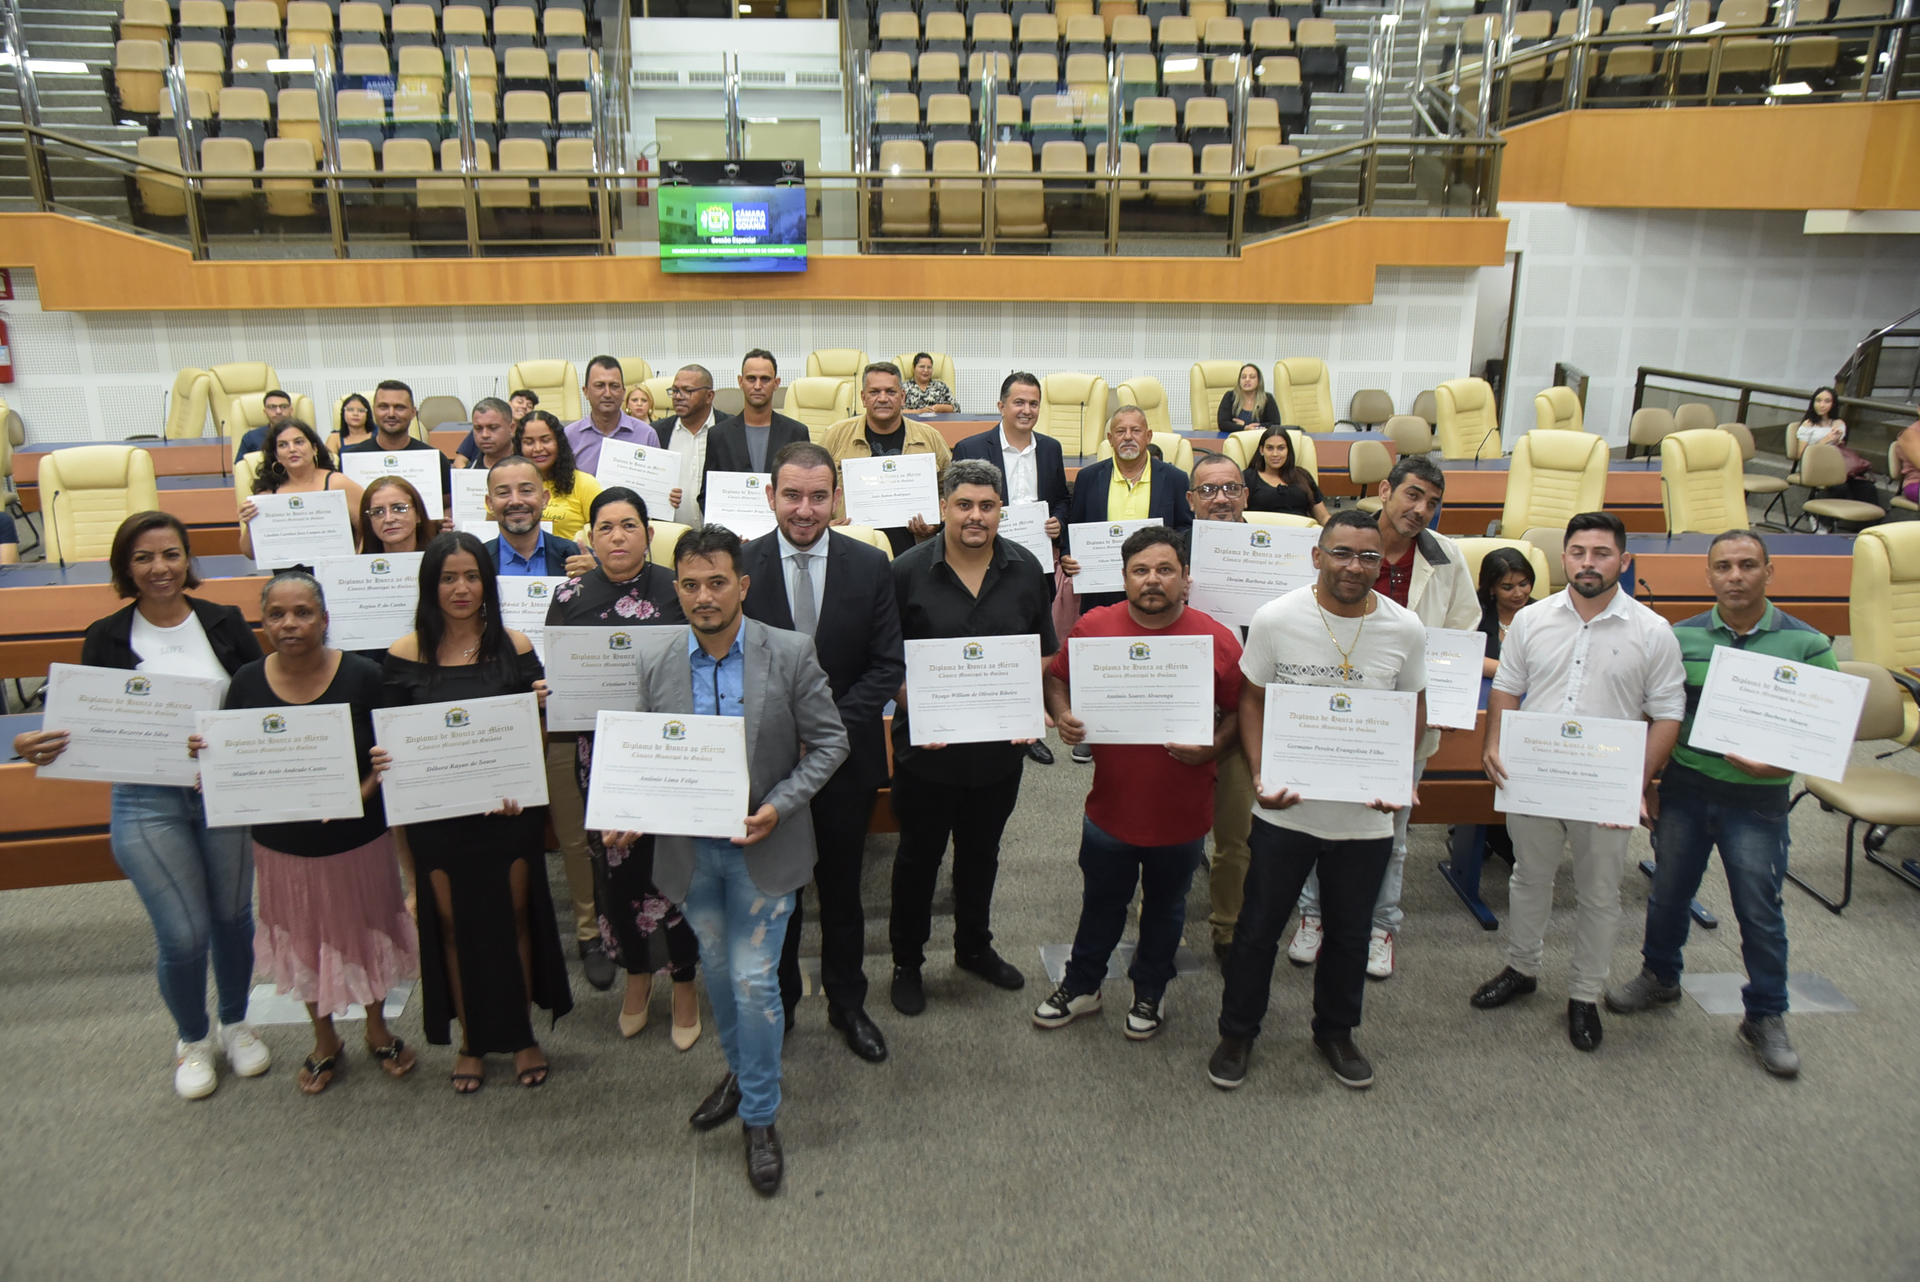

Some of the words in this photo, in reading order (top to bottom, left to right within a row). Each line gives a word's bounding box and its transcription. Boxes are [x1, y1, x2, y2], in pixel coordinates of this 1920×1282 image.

[735, 208, 766, 219] CÂMARA
[736, 221, 766, 231] GOIÂNIA
[732, 236, 757, 245] Especial
[1214, 547, 1241, 555] Diploma
[1252, 550, 1272, 558] Honra
[160, 645, 185, 655] LOVE
[997, 661, 1019, 669] Mérito
[1731, 675, 1761, 687] Diploma
[1773, 685, 1796, 695] Honra
[78, 695, 113, 704] Diploma
[127, 698, 152, 707] Honra
[165, 701, 193, 709] Mérito
[1289, 712, 1319, 721] Diploma
[1331, 715, 1353, 723] Honra
[1365, 717, 1389, 726] Mérito
[405, 734, 438, 744] Diploma
[450, 730, 475, 739] Honra
[488, 725, 514, 734] Mérito
[224, 739, 256, 747] Diploma
[442, 739, 471, 748] Municipal
[1524, 737, 1552, 745] Diploma
[260, 745, 287, 754] Municipal
[622, 741, 653, 750] Diploma
[701, 745, 726, 754] Mérito
[1336, 746, 1367, 755] Evangelista
